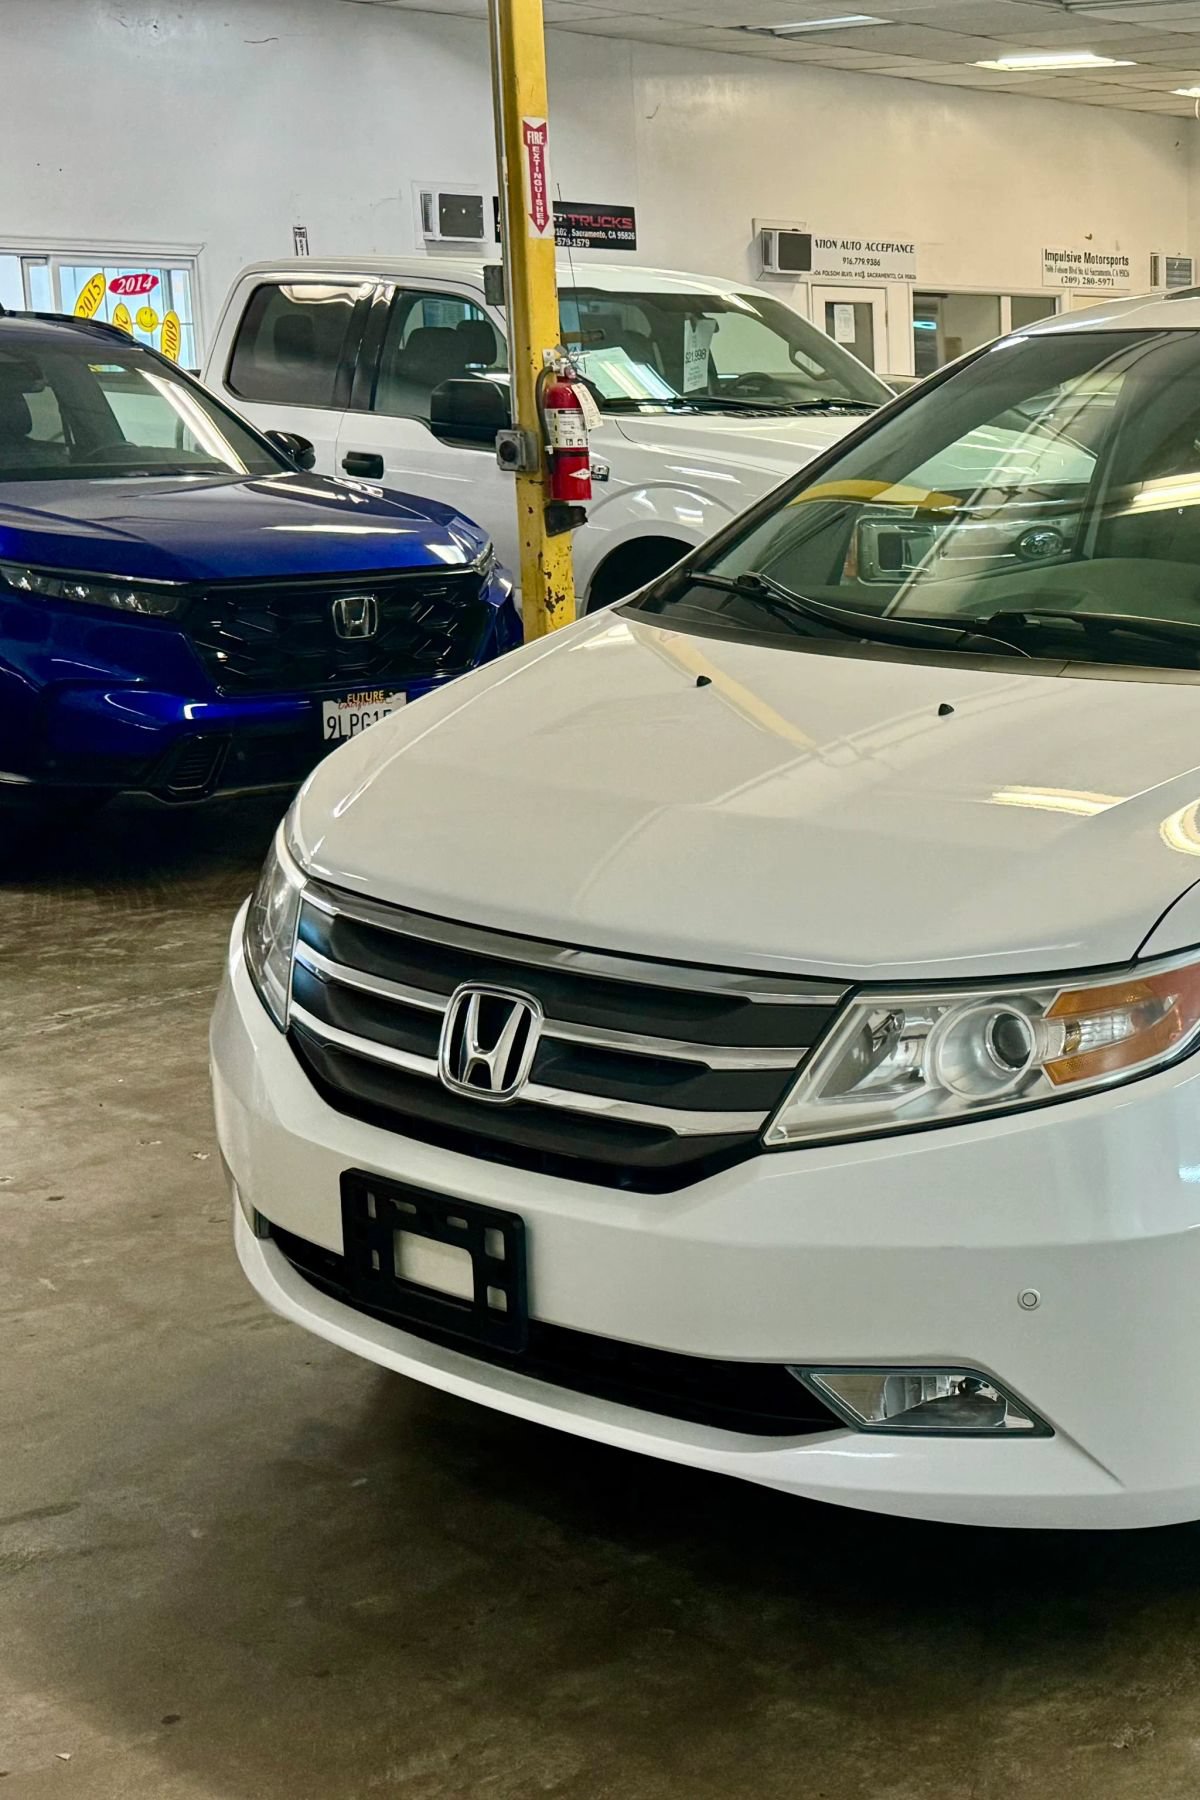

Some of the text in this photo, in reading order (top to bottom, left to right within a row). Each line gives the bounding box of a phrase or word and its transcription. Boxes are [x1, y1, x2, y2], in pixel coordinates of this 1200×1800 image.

[527, 131, 544, 145] FIRE
[532, 146, 545, 226] EXTINGUISHER
[566, 213, 633, 229] TRUCKS
[840, 241, 861, 251] AUTO
[865, 242, 915, 254] ACCEPTANCE
[1045, 249, 1129, 268] Impulsive Motorsports
[117, 276, 153, 293] 2014
[79, 279, 101, 318] 2015
[163, 320, 178, 360] 2009
[346, 690, 384, 703] FUTURE
